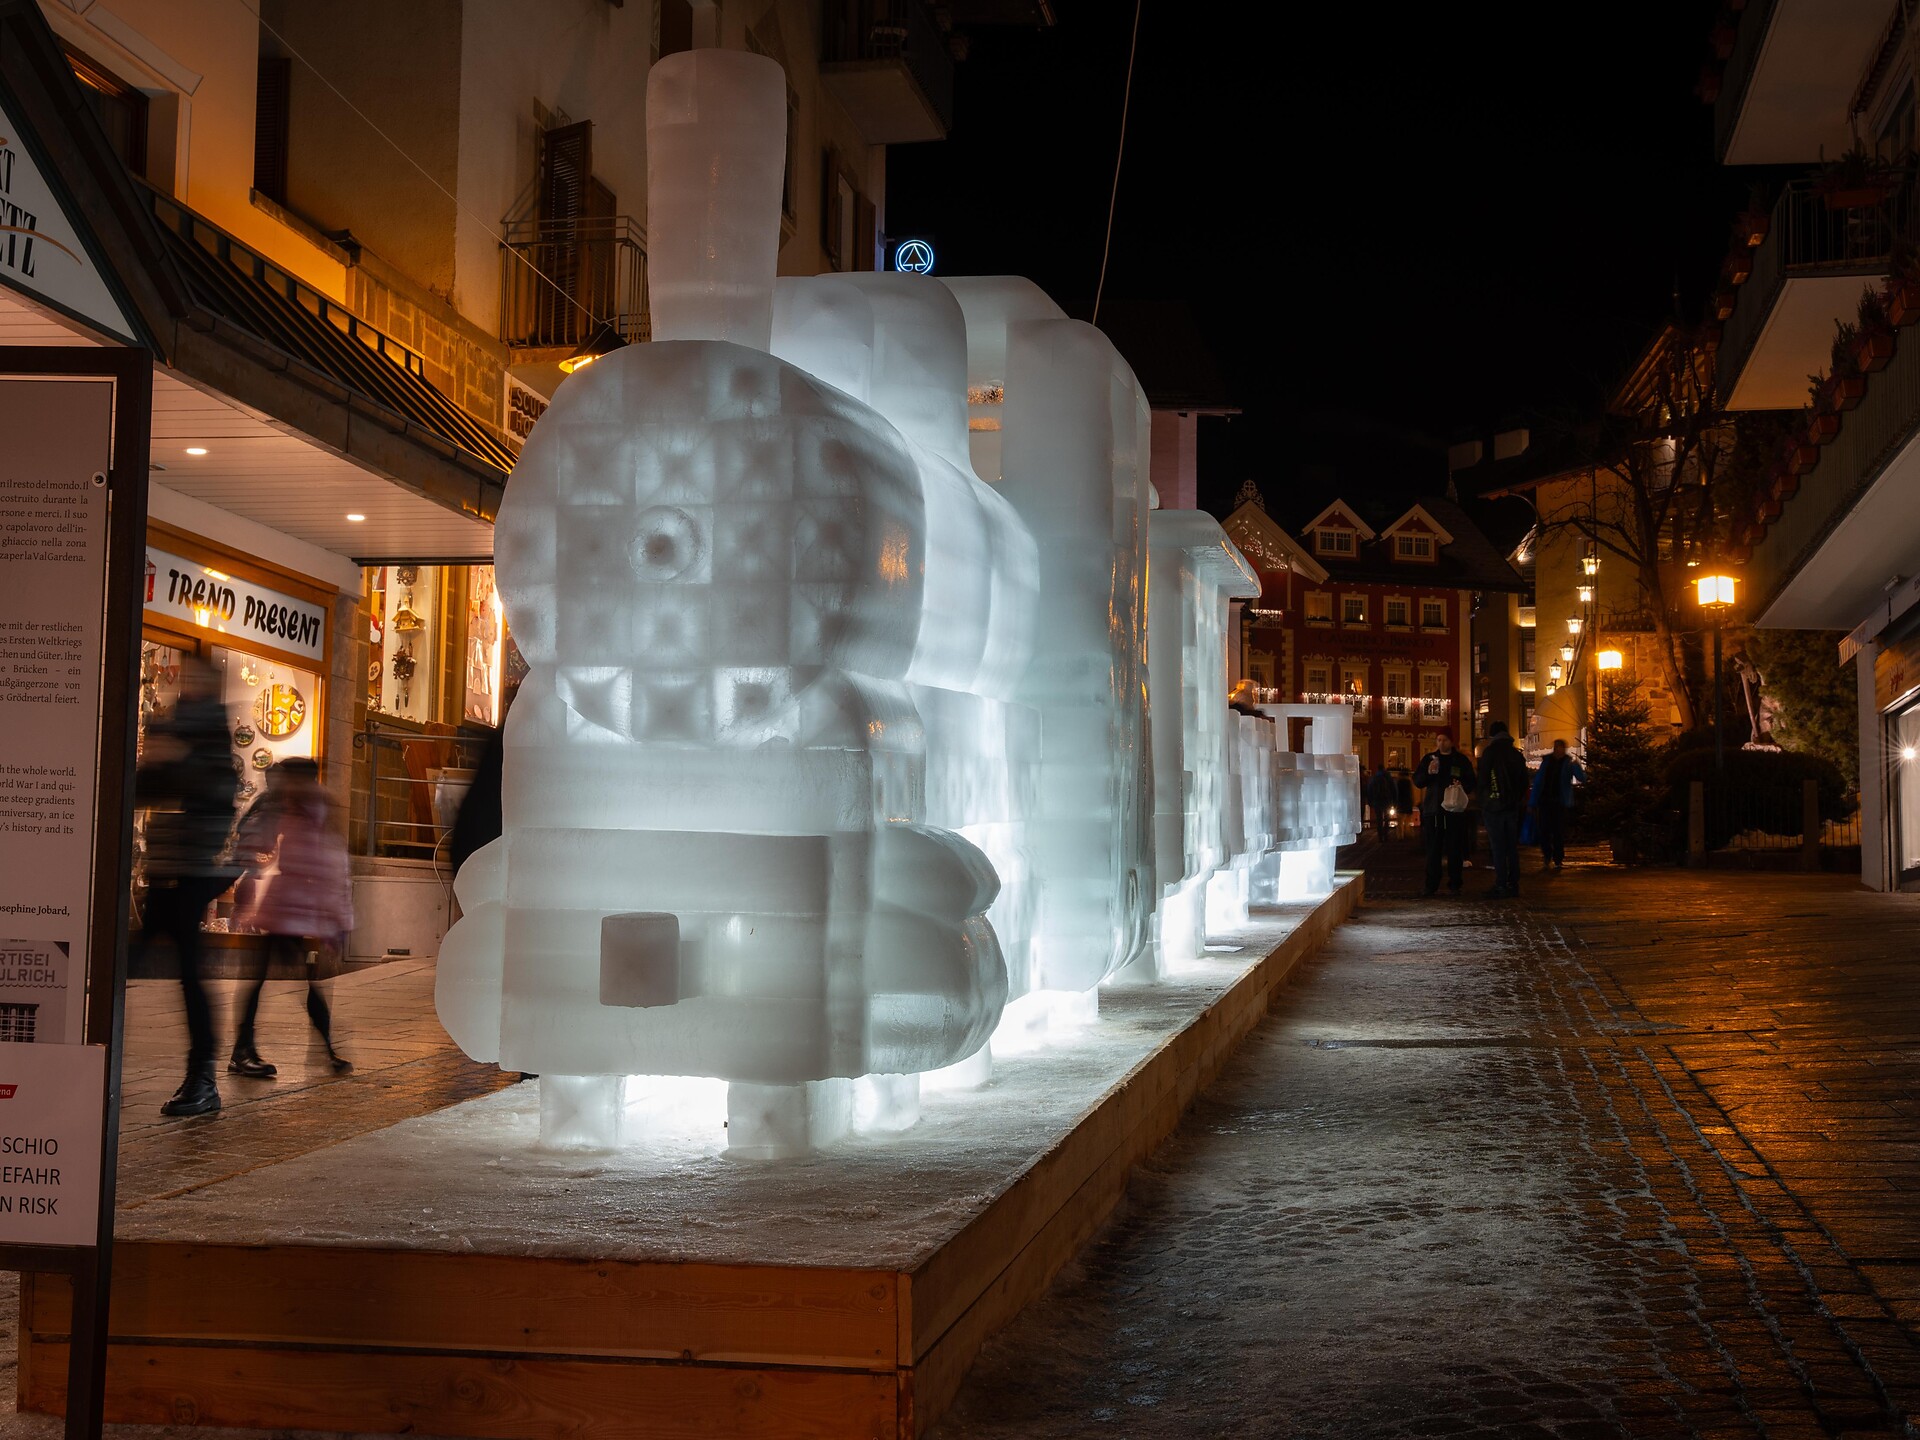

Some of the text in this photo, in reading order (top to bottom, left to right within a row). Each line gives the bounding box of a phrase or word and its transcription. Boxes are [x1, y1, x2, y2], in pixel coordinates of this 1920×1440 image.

[13, 481, 35, 489] resto
[36, 480, 49, 489] del
[50, 481, 81, 490] mondo.
[1, 495, 88, 504] costruito durante la
[35, 509, 62, 518] merci.
[6, 523, 53, 533] capolavoro
[2, 536, 38, 547] ghiaccio
[41, 537, 63, 547] nella
[33, 552, 47, 561] Val
[47, 552, 86, 562] Gardena.
[168, 568, 321, 648] TREND PRESENT
[8, 621, 23, 630] mit
[25, 621, 40, 631] der
[41, 622, 83, 632] restlichen
[9, 636, 36, 645] Ersten
[37, 636, 83, 648] Weltkriegs
[20, 650, 36, 659] und
[37, 651, 63, 661] Güter.
[64, 651, 82, 661] Ihre
[13, 664, 48, 674] Brücken
[68, 666, 81, 675] ein
[64, 682, 80, 690] von
[6, 692, 52, 703] Grödnertal
[54, 693, 80, 704] feiert.
[6, 764, 21, 774] the
[22, 765, 48, 776] whole
[49, 766, 77, 777] world.
[16, 780, 34, 789] War
[40, 780, 57, 790] and
[58, 782, 76, 793] qui-
[10, 795, 34, 805] steep
[35, 794, 75, 806] gradients
[62, 811, 75, 820] ice
[11, 822, 42, 835] history
[44, 824, 61, 834] and
[63, 825, 74, 834] its
[36, 904, 70, 917] Jobard,
[0, 1166, 61, 1186] EFAHR
[19, 1196, 59, 1216] RISK
